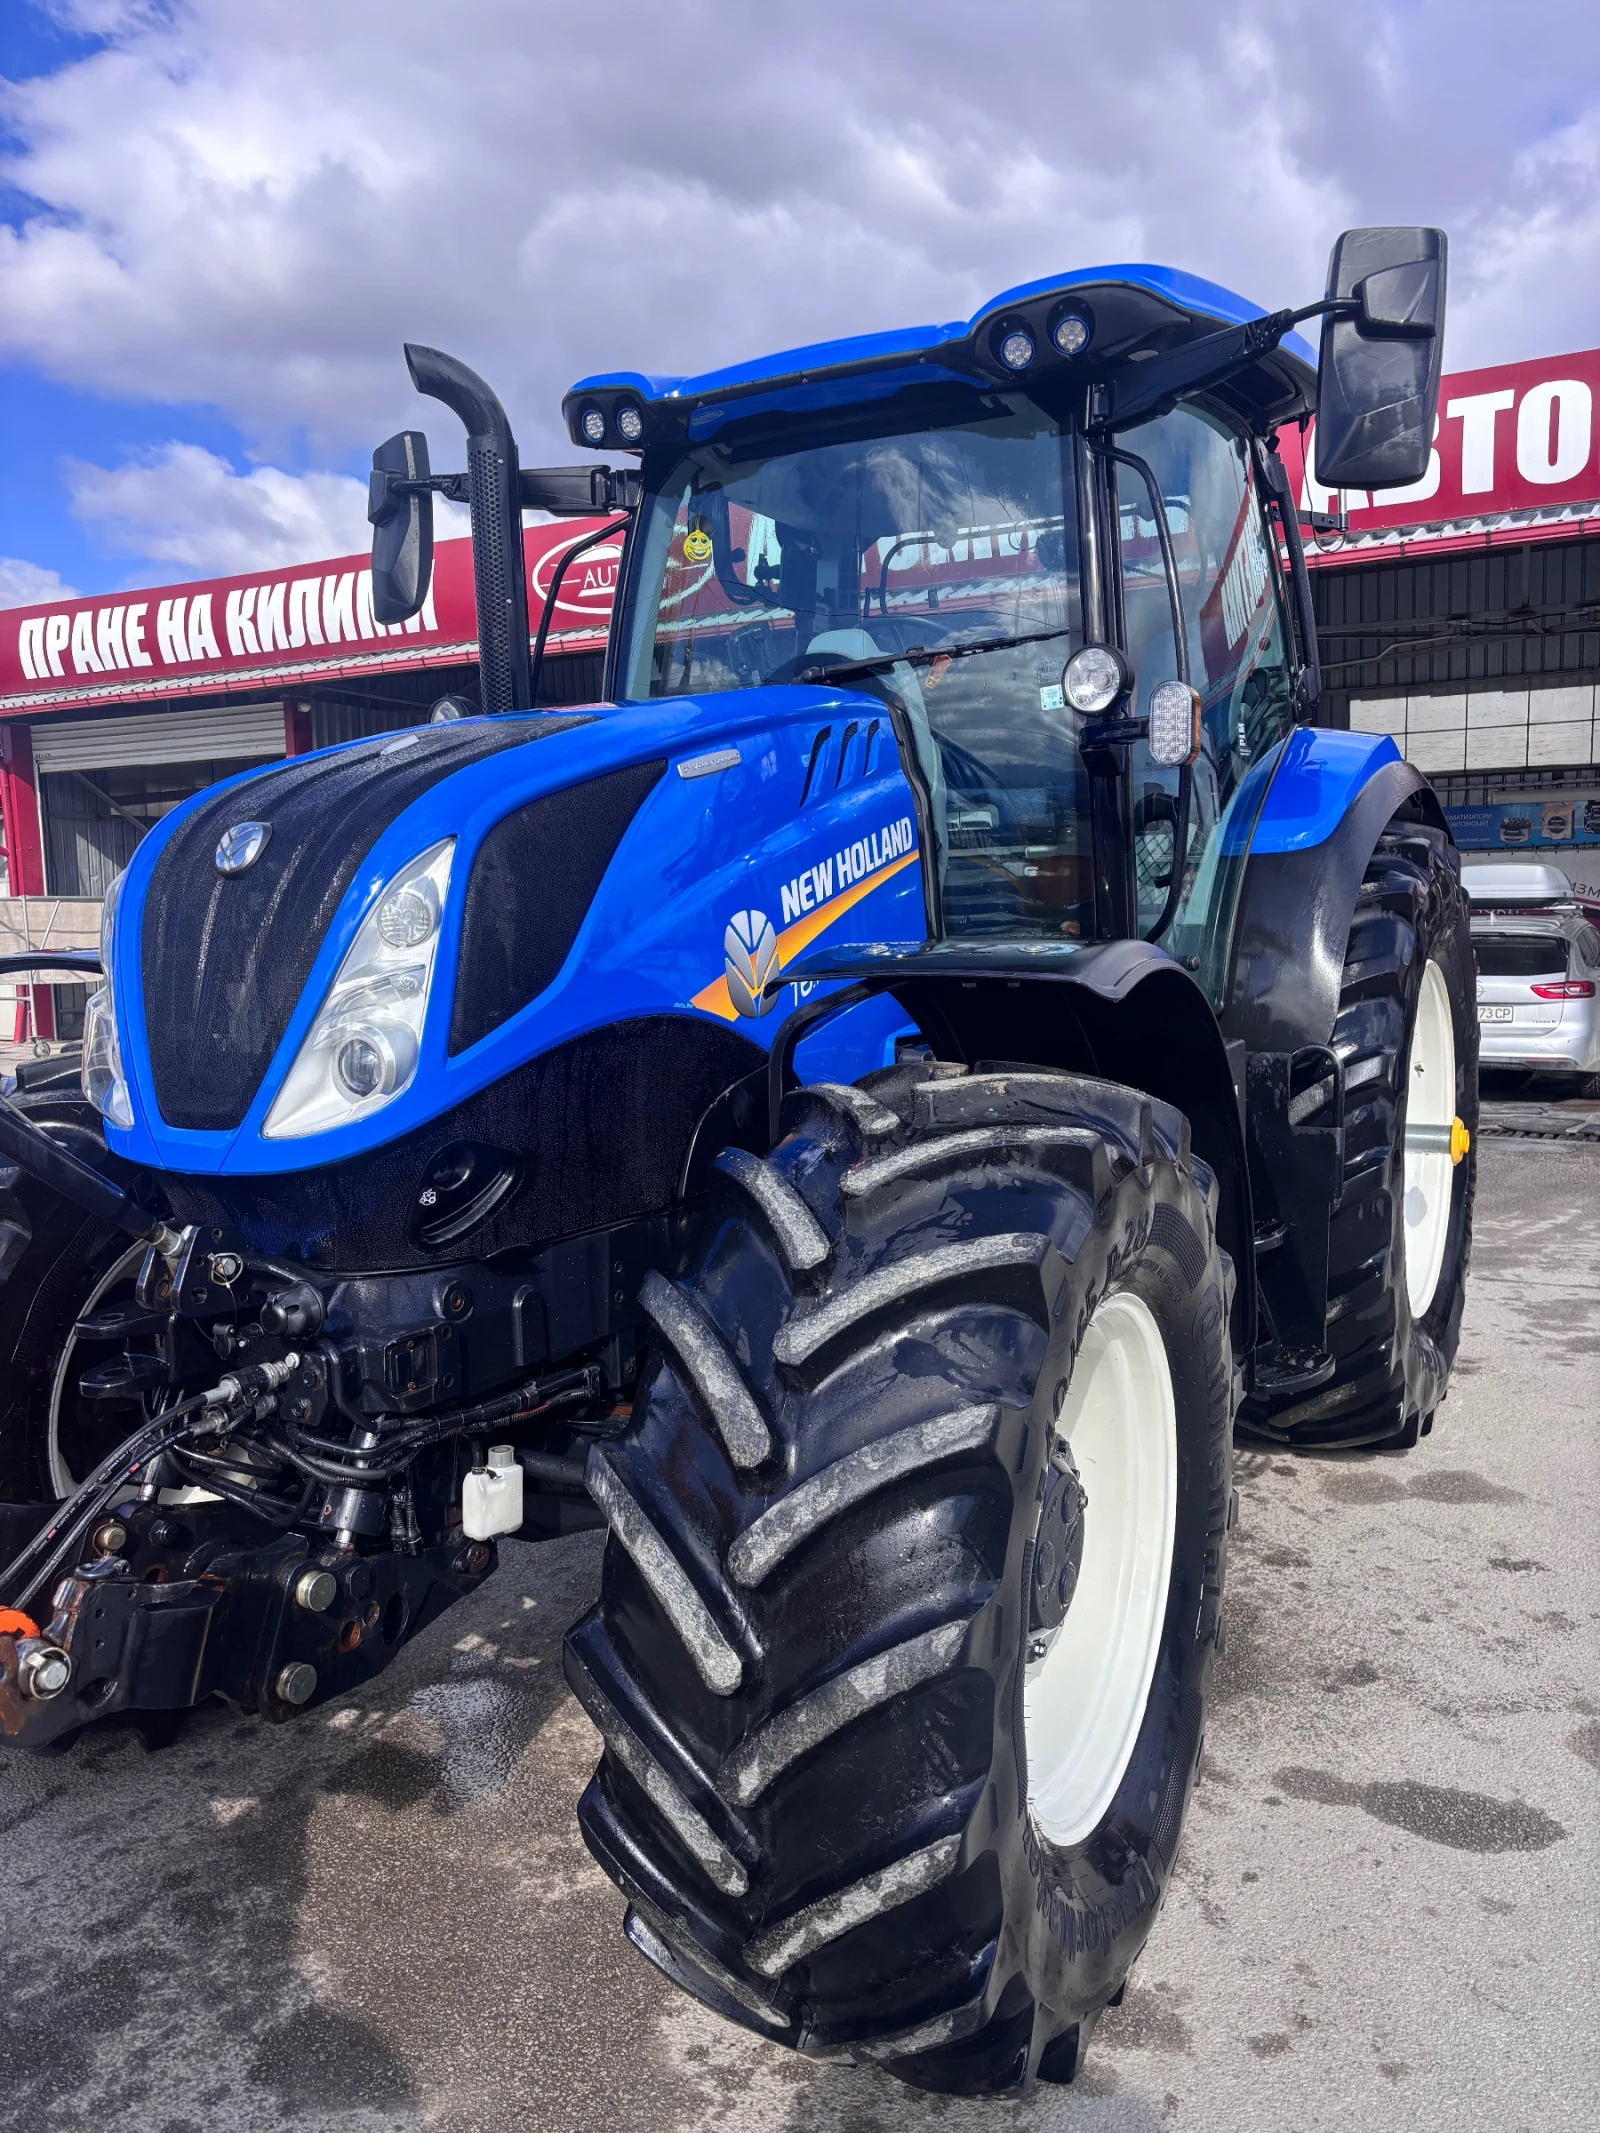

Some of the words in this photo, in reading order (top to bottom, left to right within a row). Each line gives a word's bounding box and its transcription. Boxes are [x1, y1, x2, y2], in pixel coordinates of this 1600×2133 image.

[18, 602, 154, 680] ПРАНЕ
[156, 593, 223, 664] НА
[780, 857, 833, 925] NEW
[835, 816, 913, 890] HOLLAND
